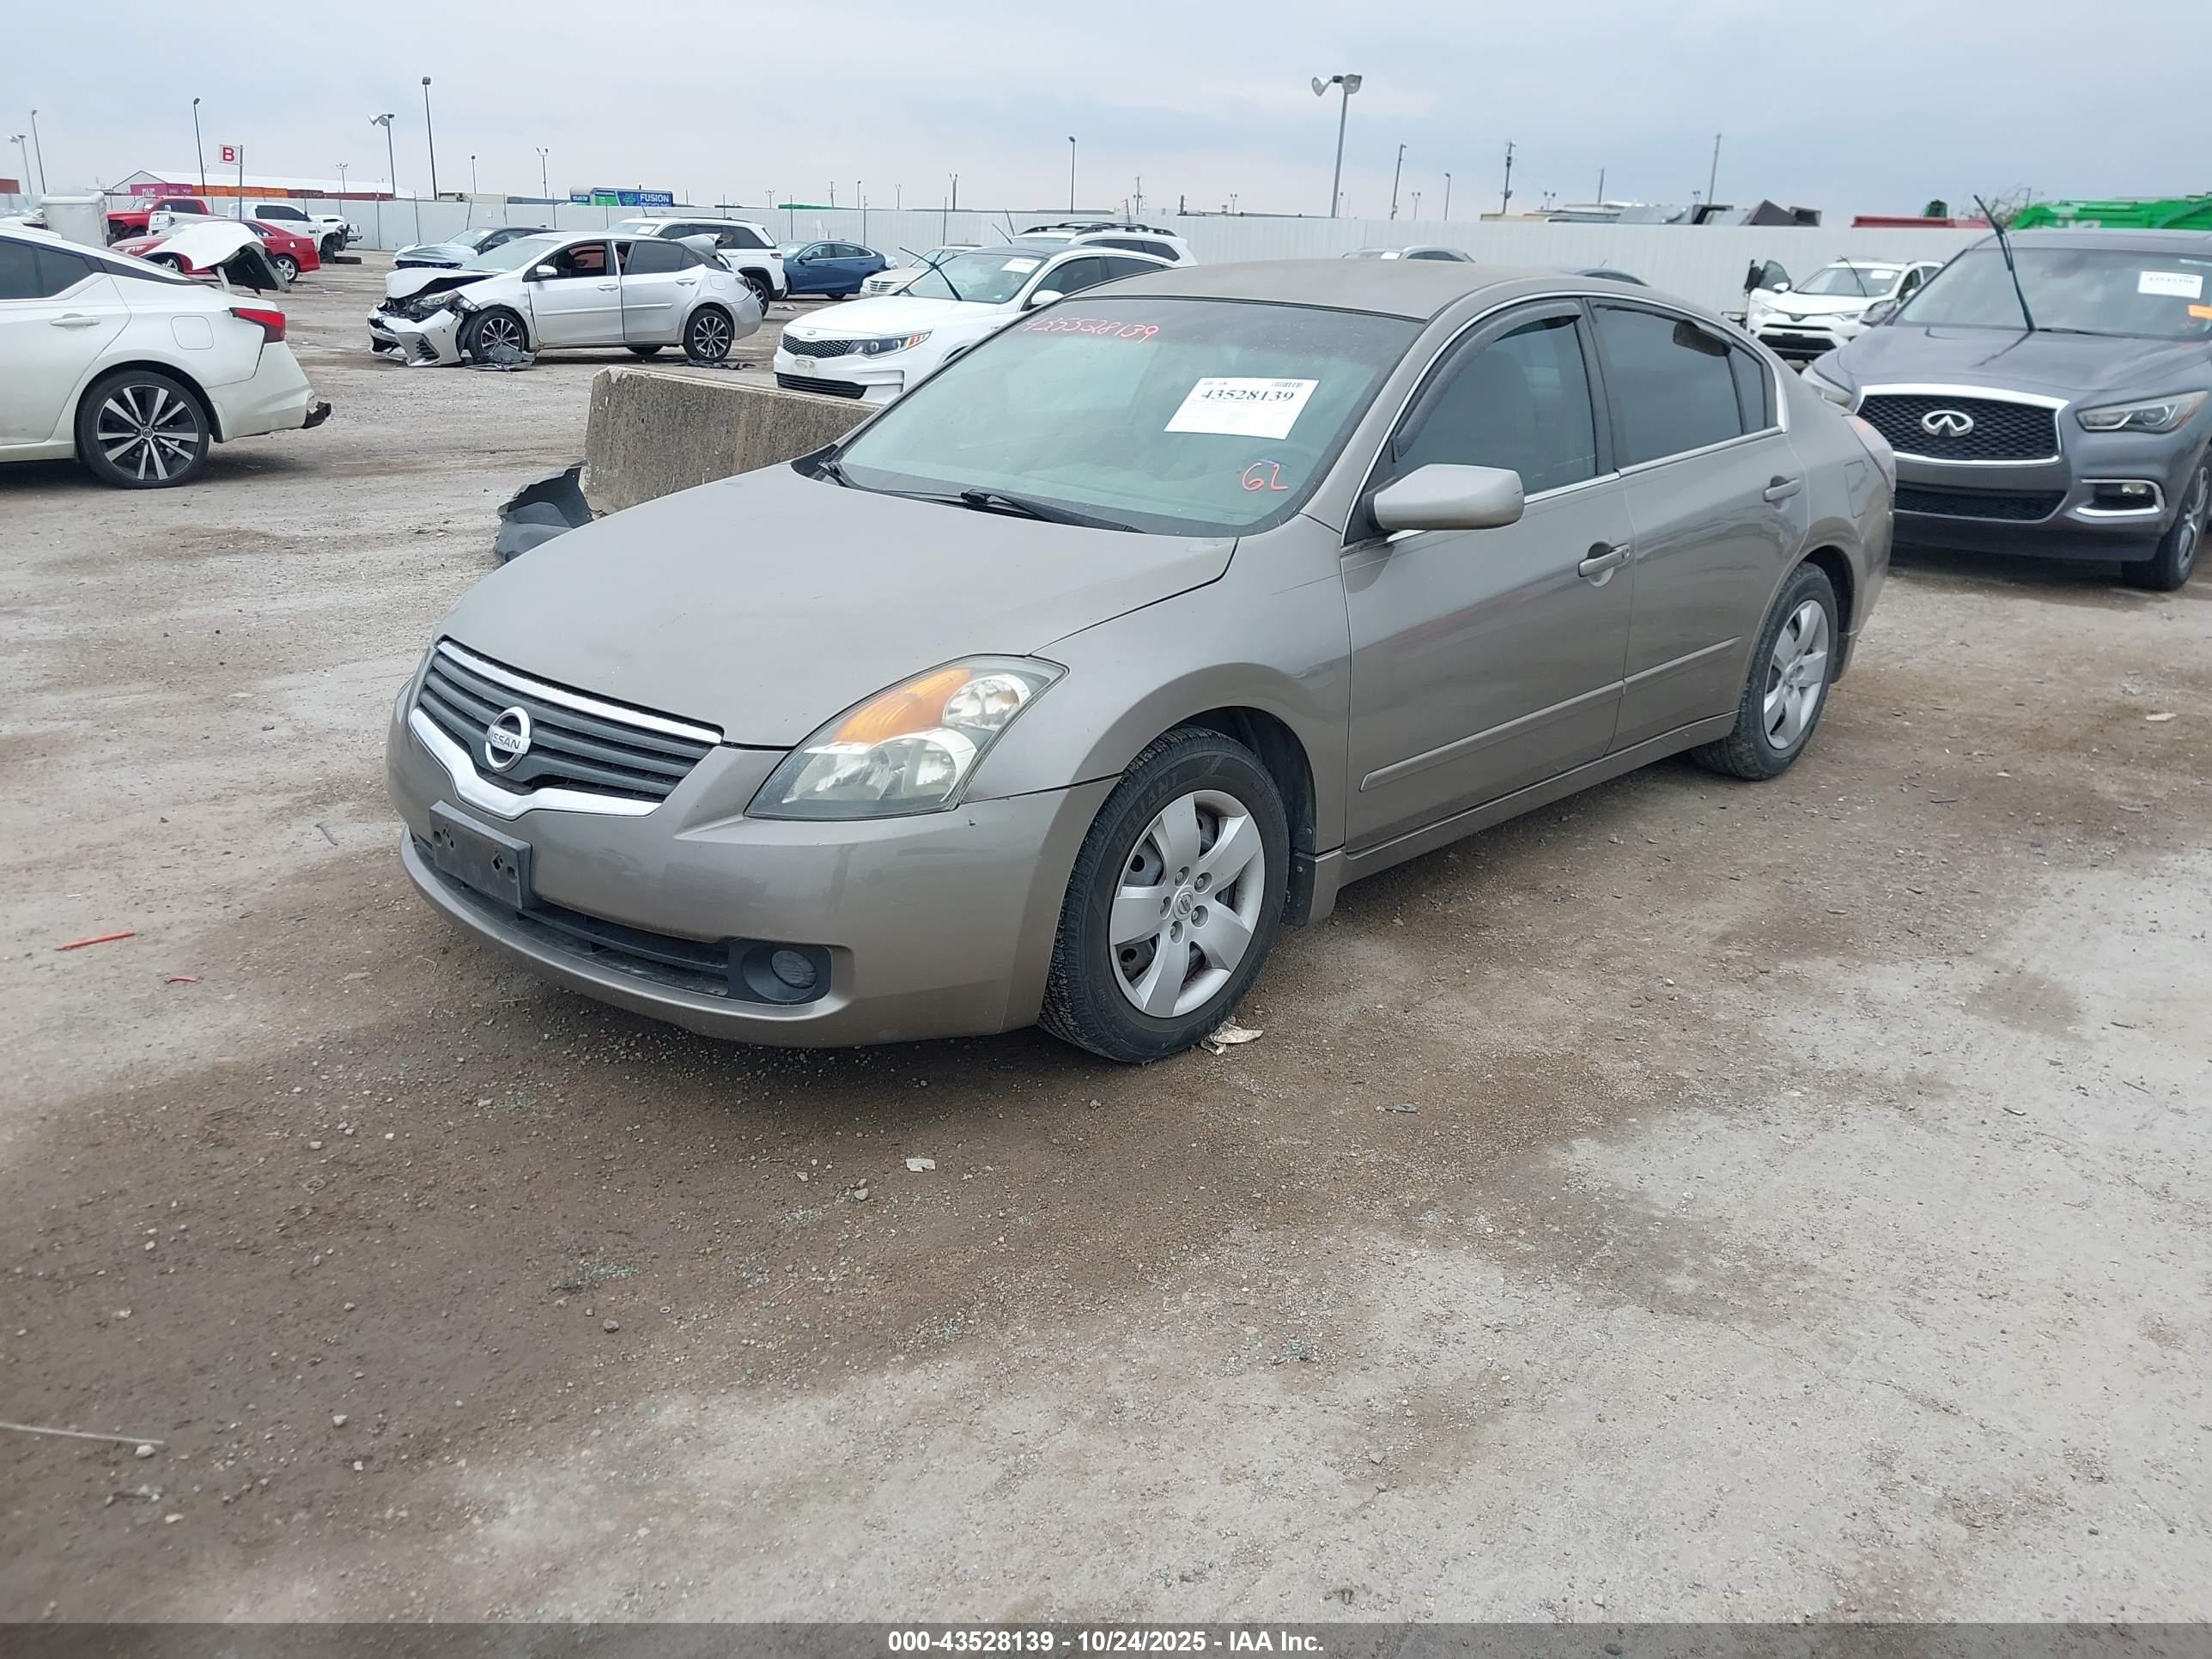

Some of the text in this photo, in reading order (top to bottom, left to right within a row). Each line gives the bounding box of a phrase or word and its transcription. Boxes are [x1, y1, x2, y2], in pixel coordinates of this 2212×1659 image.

[222, 147, 234, 161] B
[640, 193, 669, 203] FUSION
[1200, 388, 1295, 402] 43528139
